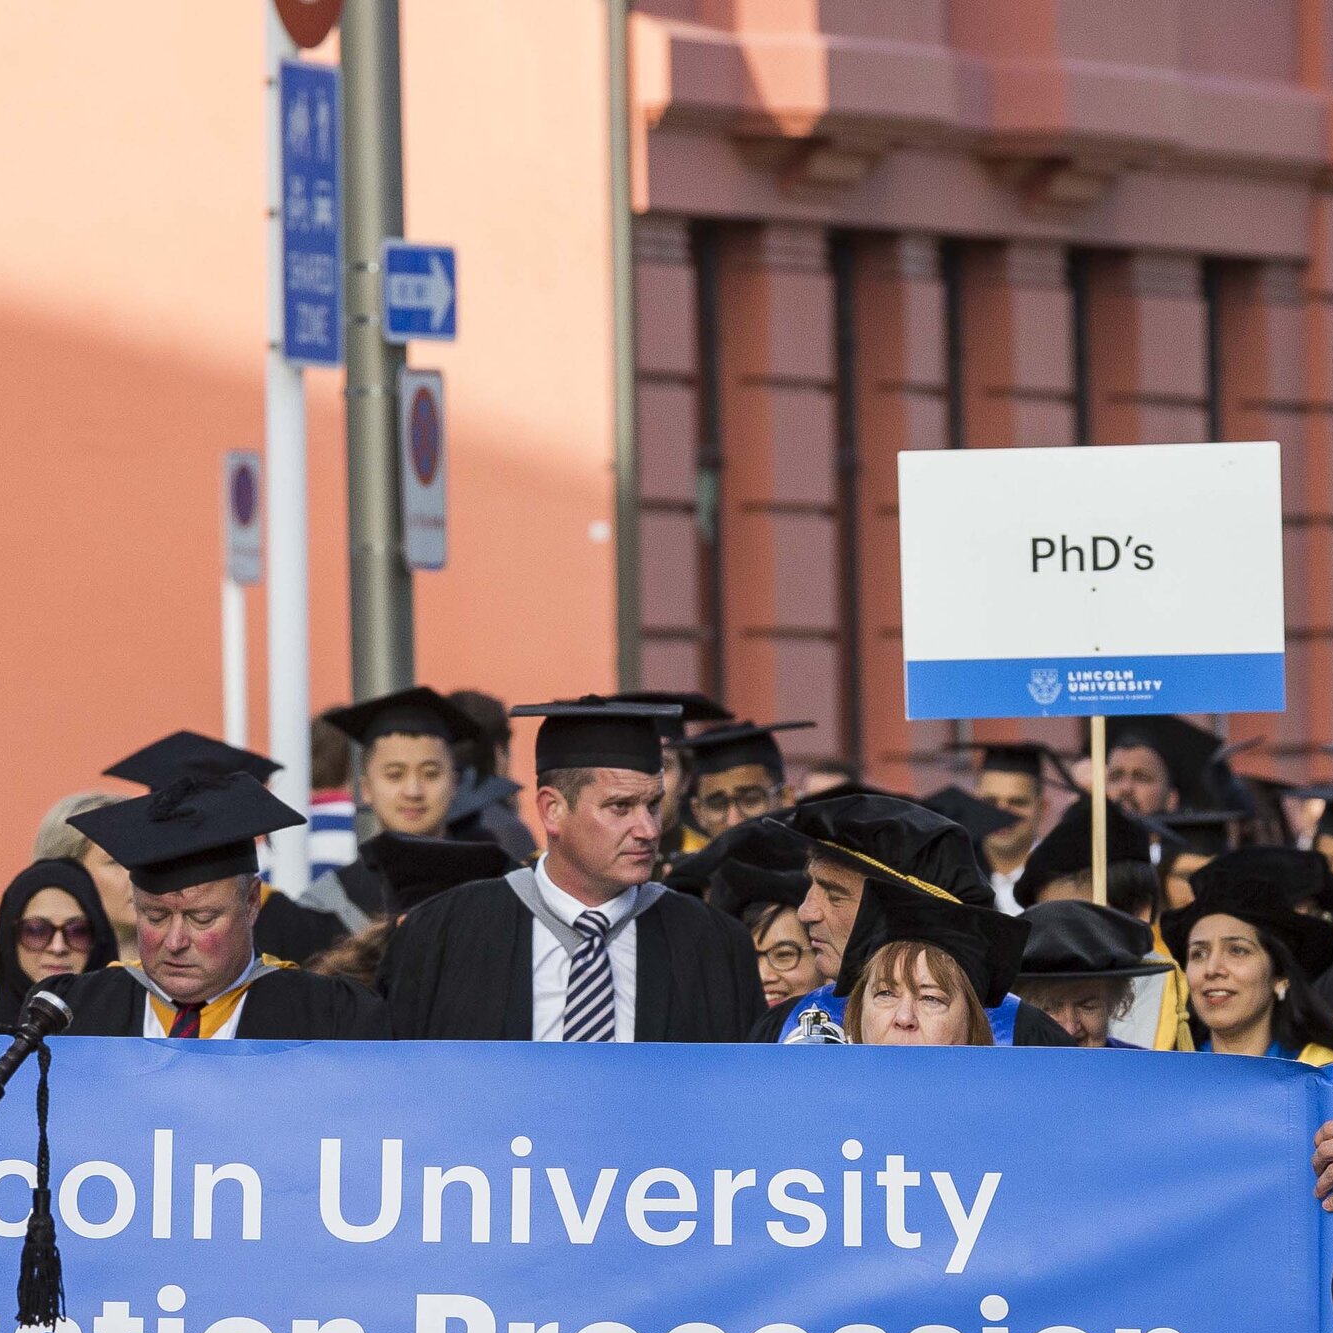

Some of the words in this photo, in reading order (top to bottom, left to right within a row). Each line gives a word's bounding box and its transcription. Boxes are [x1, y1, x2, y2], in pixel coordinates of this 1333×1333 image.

[1030, 535, 1155, 573] PhD's
[1067, 670, 1134, 681] LINCOLN
[1067, 680, 1163, 693] UNIVERSITY
[319, 1136, 1003, 1274] University
